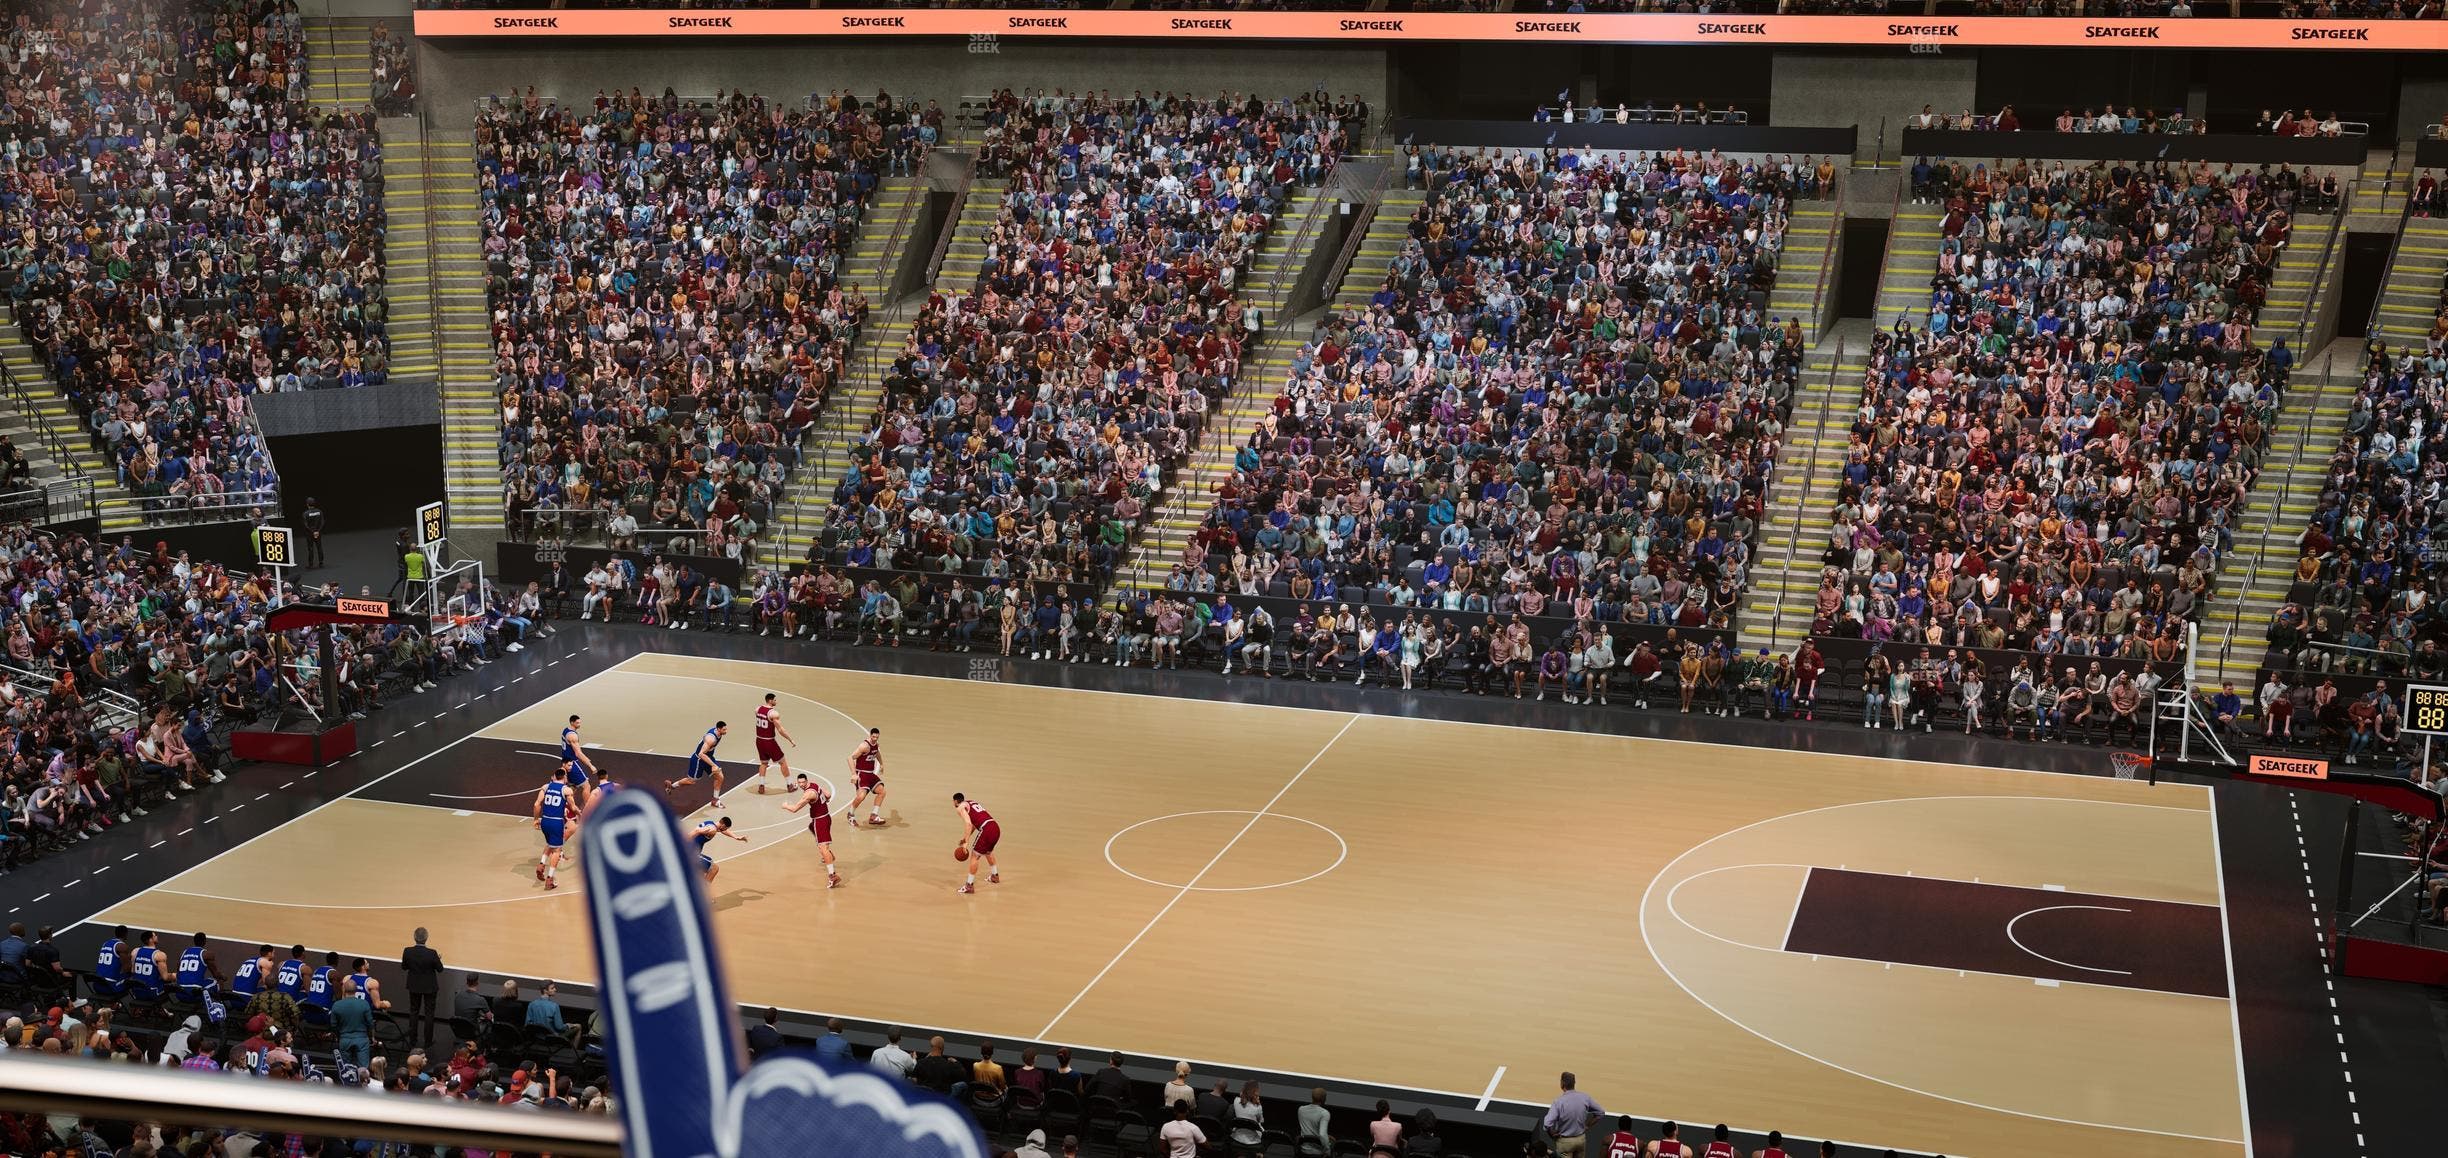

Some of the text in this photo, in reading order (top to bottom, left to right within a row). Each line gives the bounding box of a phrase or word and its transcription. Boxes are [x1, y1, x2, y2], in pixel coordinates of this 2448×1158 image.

[494, 17, 558, 29] SEATGEEK
[669, 16, 733, 28] SEATGEEK
[843, 16, 905, 28] SEATGEEK
[1009, 17, 1068, 28] SEATGEEK
[1172, 18, 1233, 30] SEATGEEK
[1340, 20, 1404, 31] SEATGEEK
[1516, 22, 1581, 33] SEATGEEK
[1698, 23, 1767, 35] SEATGEEK
[1888, 24, 1960, 37] SEATGEEK
[2086, 25, 2160, 40] SEATGEEK
[2292, 28, 2369, 41] SEATGEEK
[263, 531, 284, 543] 88 88
[428, 521, 439, 540] 88
[266, 544, 283, 561] 88
[342, 601, 384, 615] SEATGEEK
[2416, 692, 2431, 704] 88
[2418, 707, 2445, 729] 88
[2258, 759, 2319, 776] SEATGEEK
[545, 794, 562, 807] 00
[135, 963, 153, 976] 00
[179, 959, 200, 972] 00
[278, 971, 298, 986] 00
[310, 980, 326, 994] 00
